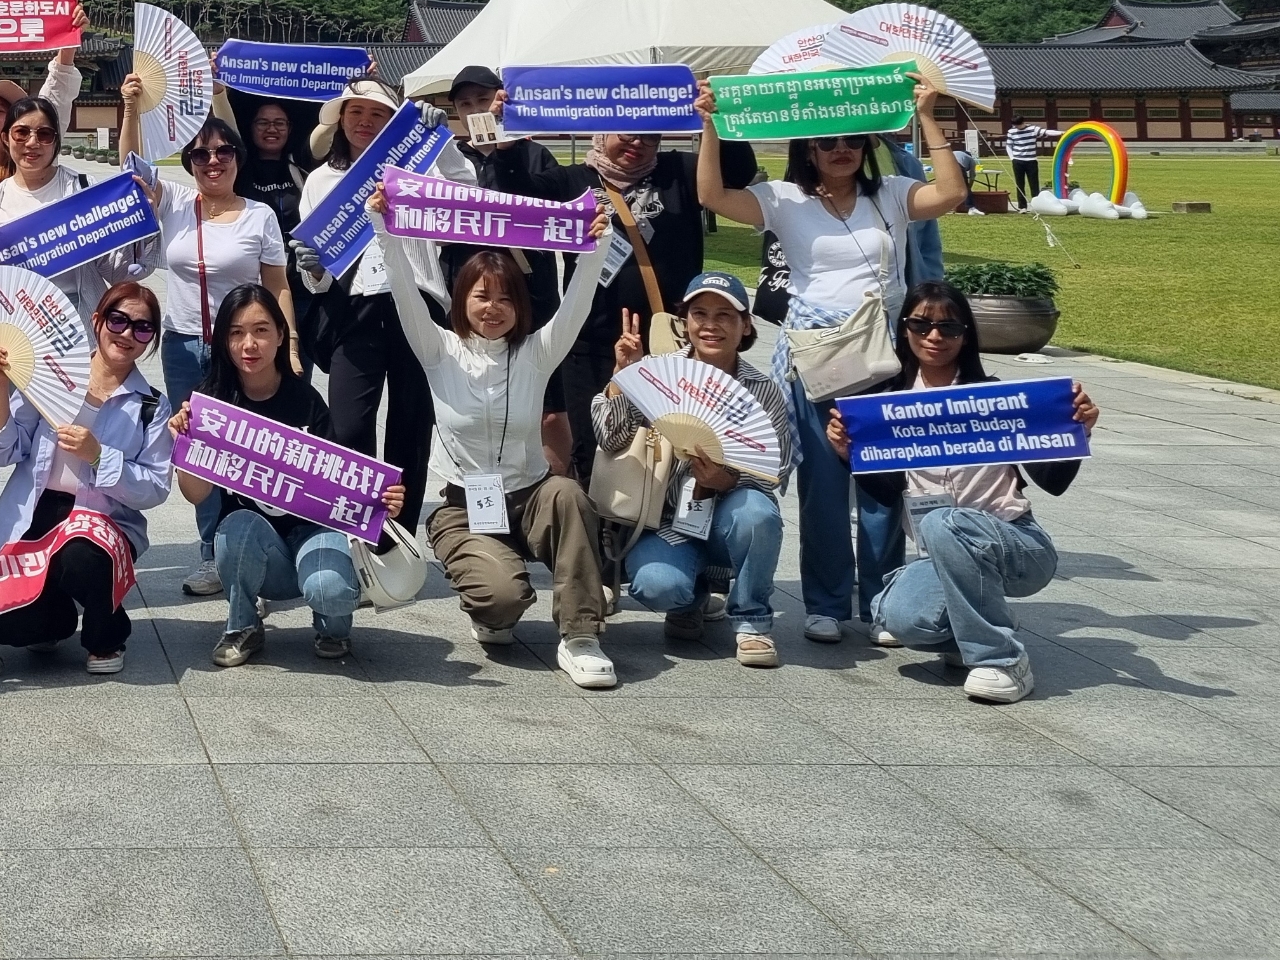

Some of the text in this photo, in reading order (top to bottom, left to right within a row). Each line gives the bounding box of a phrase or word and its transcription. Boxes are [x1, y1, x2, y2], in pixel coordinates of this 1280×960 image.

[178, 50, 189, 96] 대한민국의
[219, 71, 237, 83] The
[239, 75, 299, 88] Immigration
[220, 55, 365, 80] Ansan's new challenge!
[514, 84, 693, 102] Ansan's new challenge!
[515, 104, 693, 120] The Immigration Department!
[38, 224, 68, 246] new
[69, 189, 141, 231] challenge!
[77, 209, 146, 247] Department!
[313, 205, 355, 249] Ansan's
[354, 177, 379, 206] new
[395, 204, 584, 246] 和移民厅一起!
[325, 241, 346, 259] The
[15, 288, 56, 338] 대한민국의
[41, 293, 70, 326] 안산의
[51, 322, 84, 357] 길
[881, 392, 1028, 421] Kantor Imigrant
[892, 417, 1026, 439] Kota Antar Budaya
[196, 407, 386, 499] 安山的新挑战!
[860, 432, 1075, 462] diharapkan berada di Ansan
[185, 438, 374, 532] 和移民厅一起!
